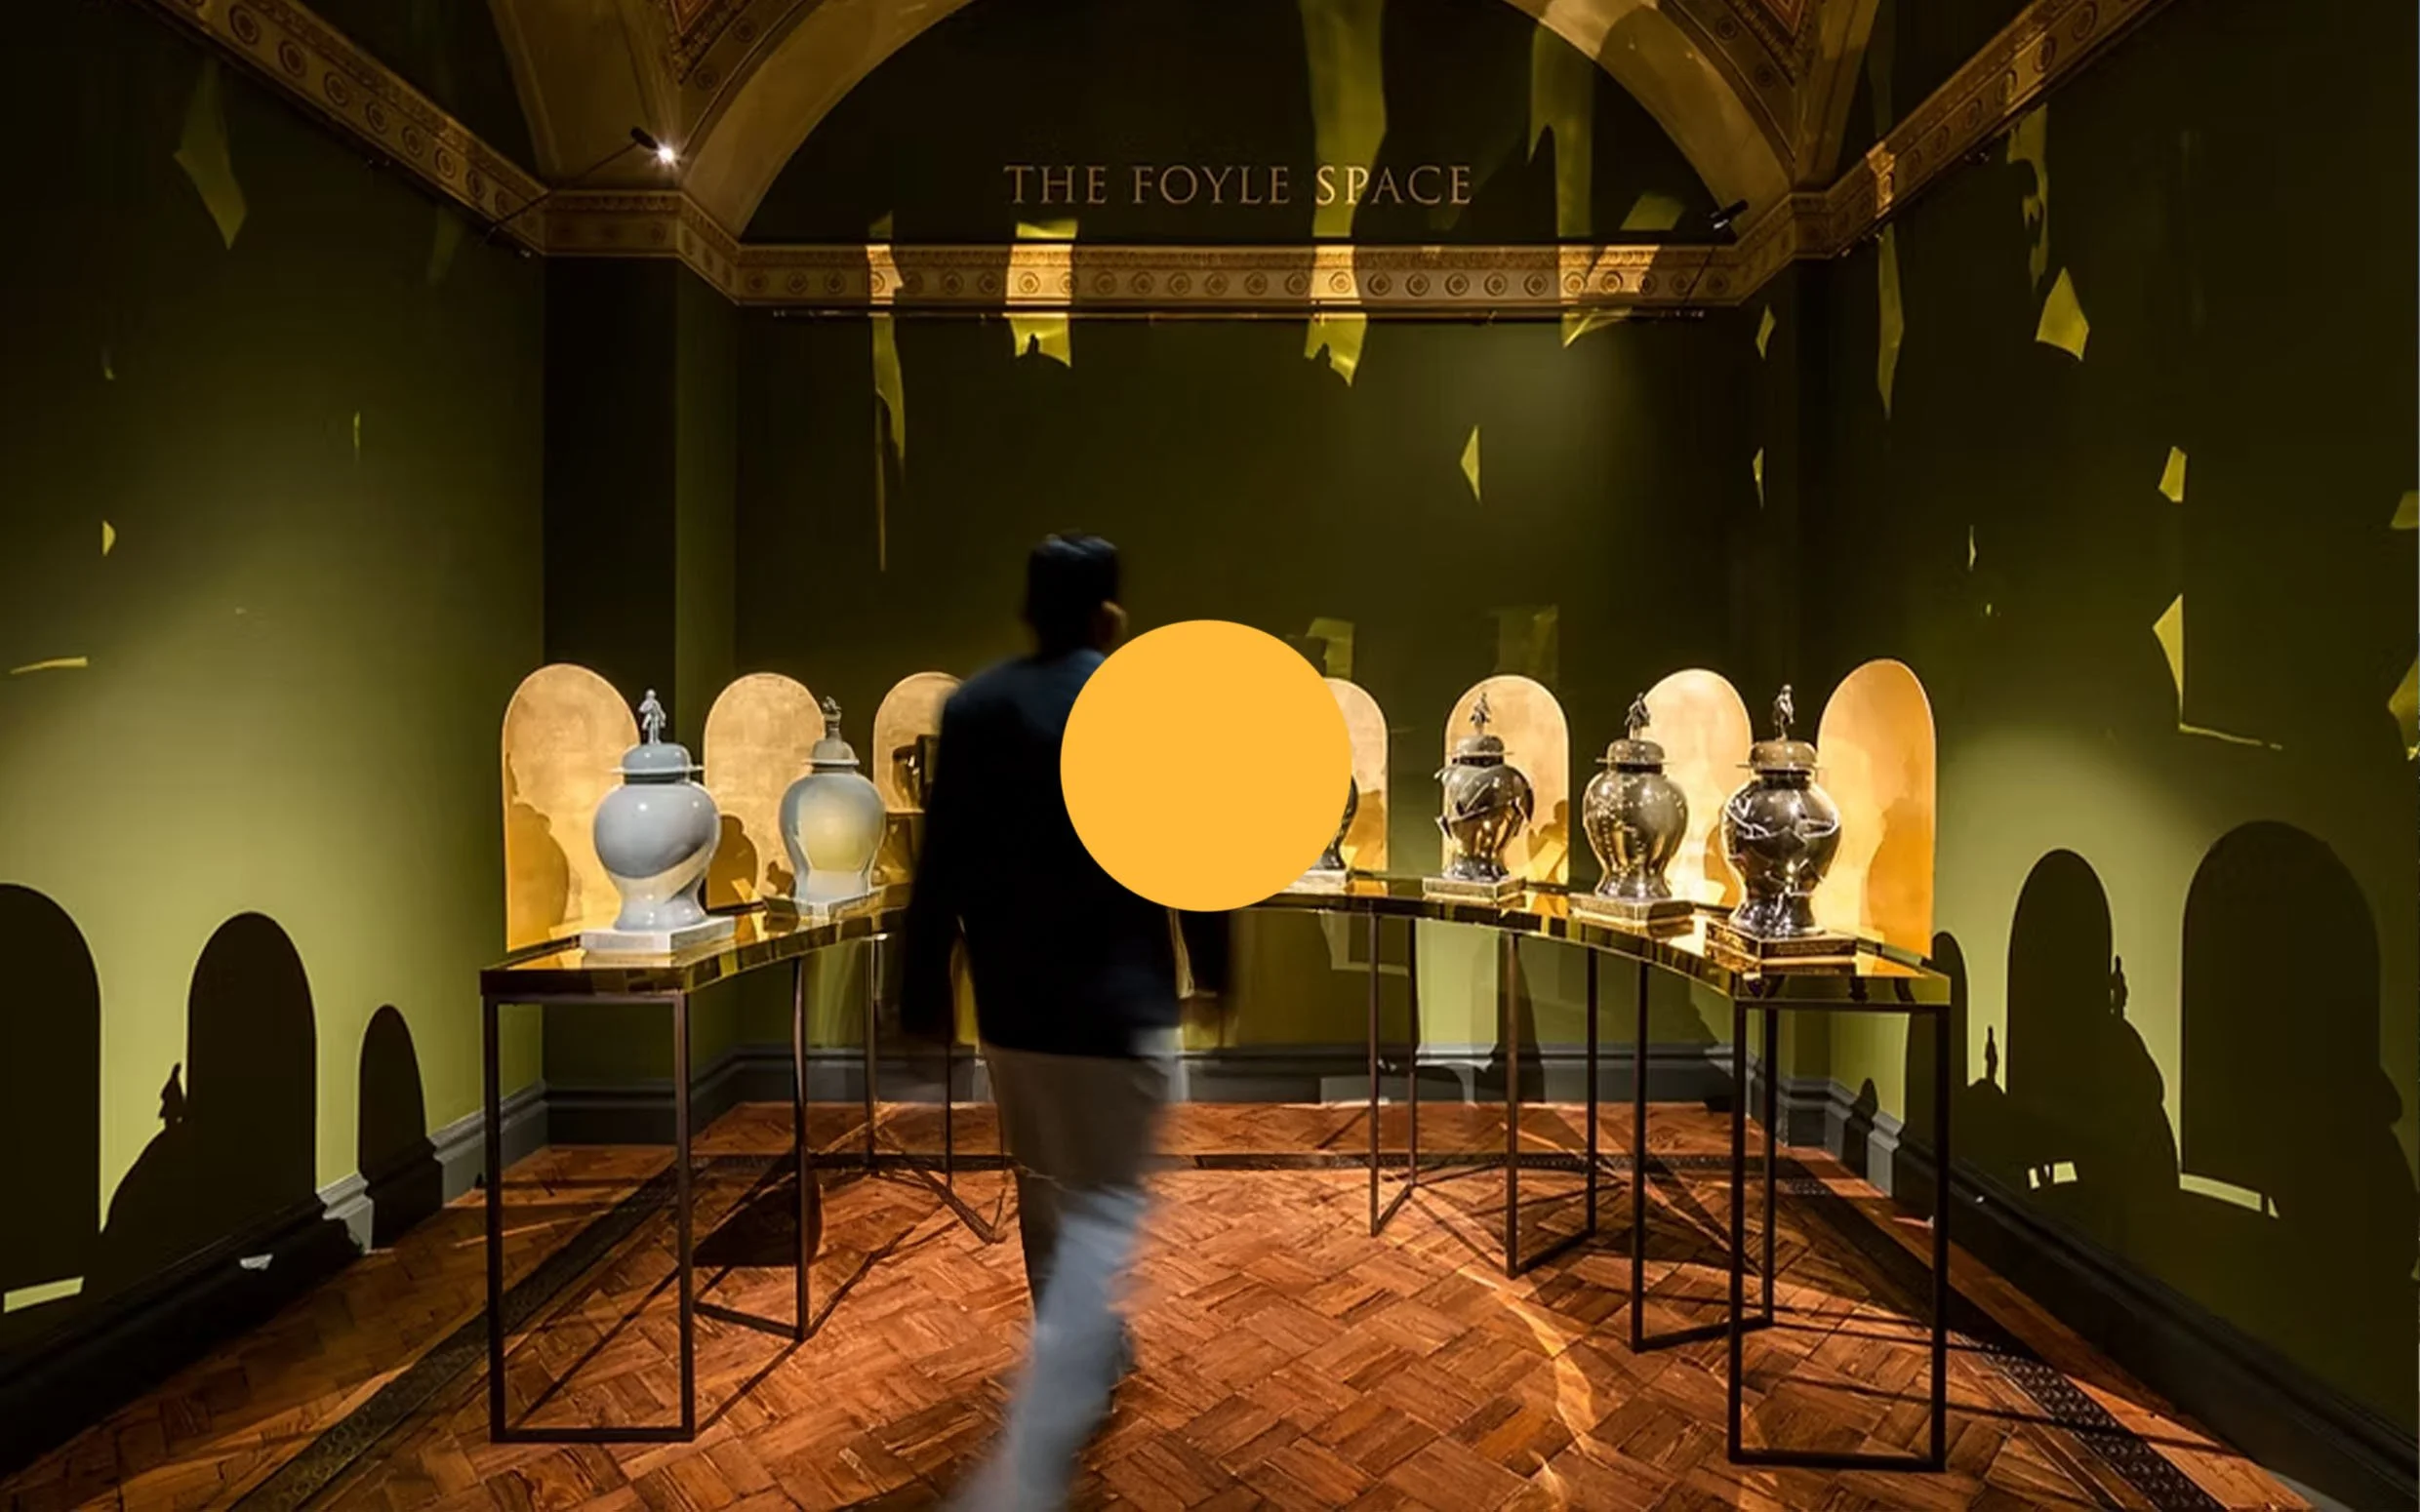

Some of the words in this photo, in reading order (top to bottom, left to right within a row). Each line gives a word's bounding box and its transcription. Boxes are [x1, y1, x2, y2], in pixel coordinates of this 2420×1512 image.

[1003, 164, 1108, 204] THE
[1132, 164, 1290, 205] FOYLE
[1314, 164, 1472, 206] SPACE
